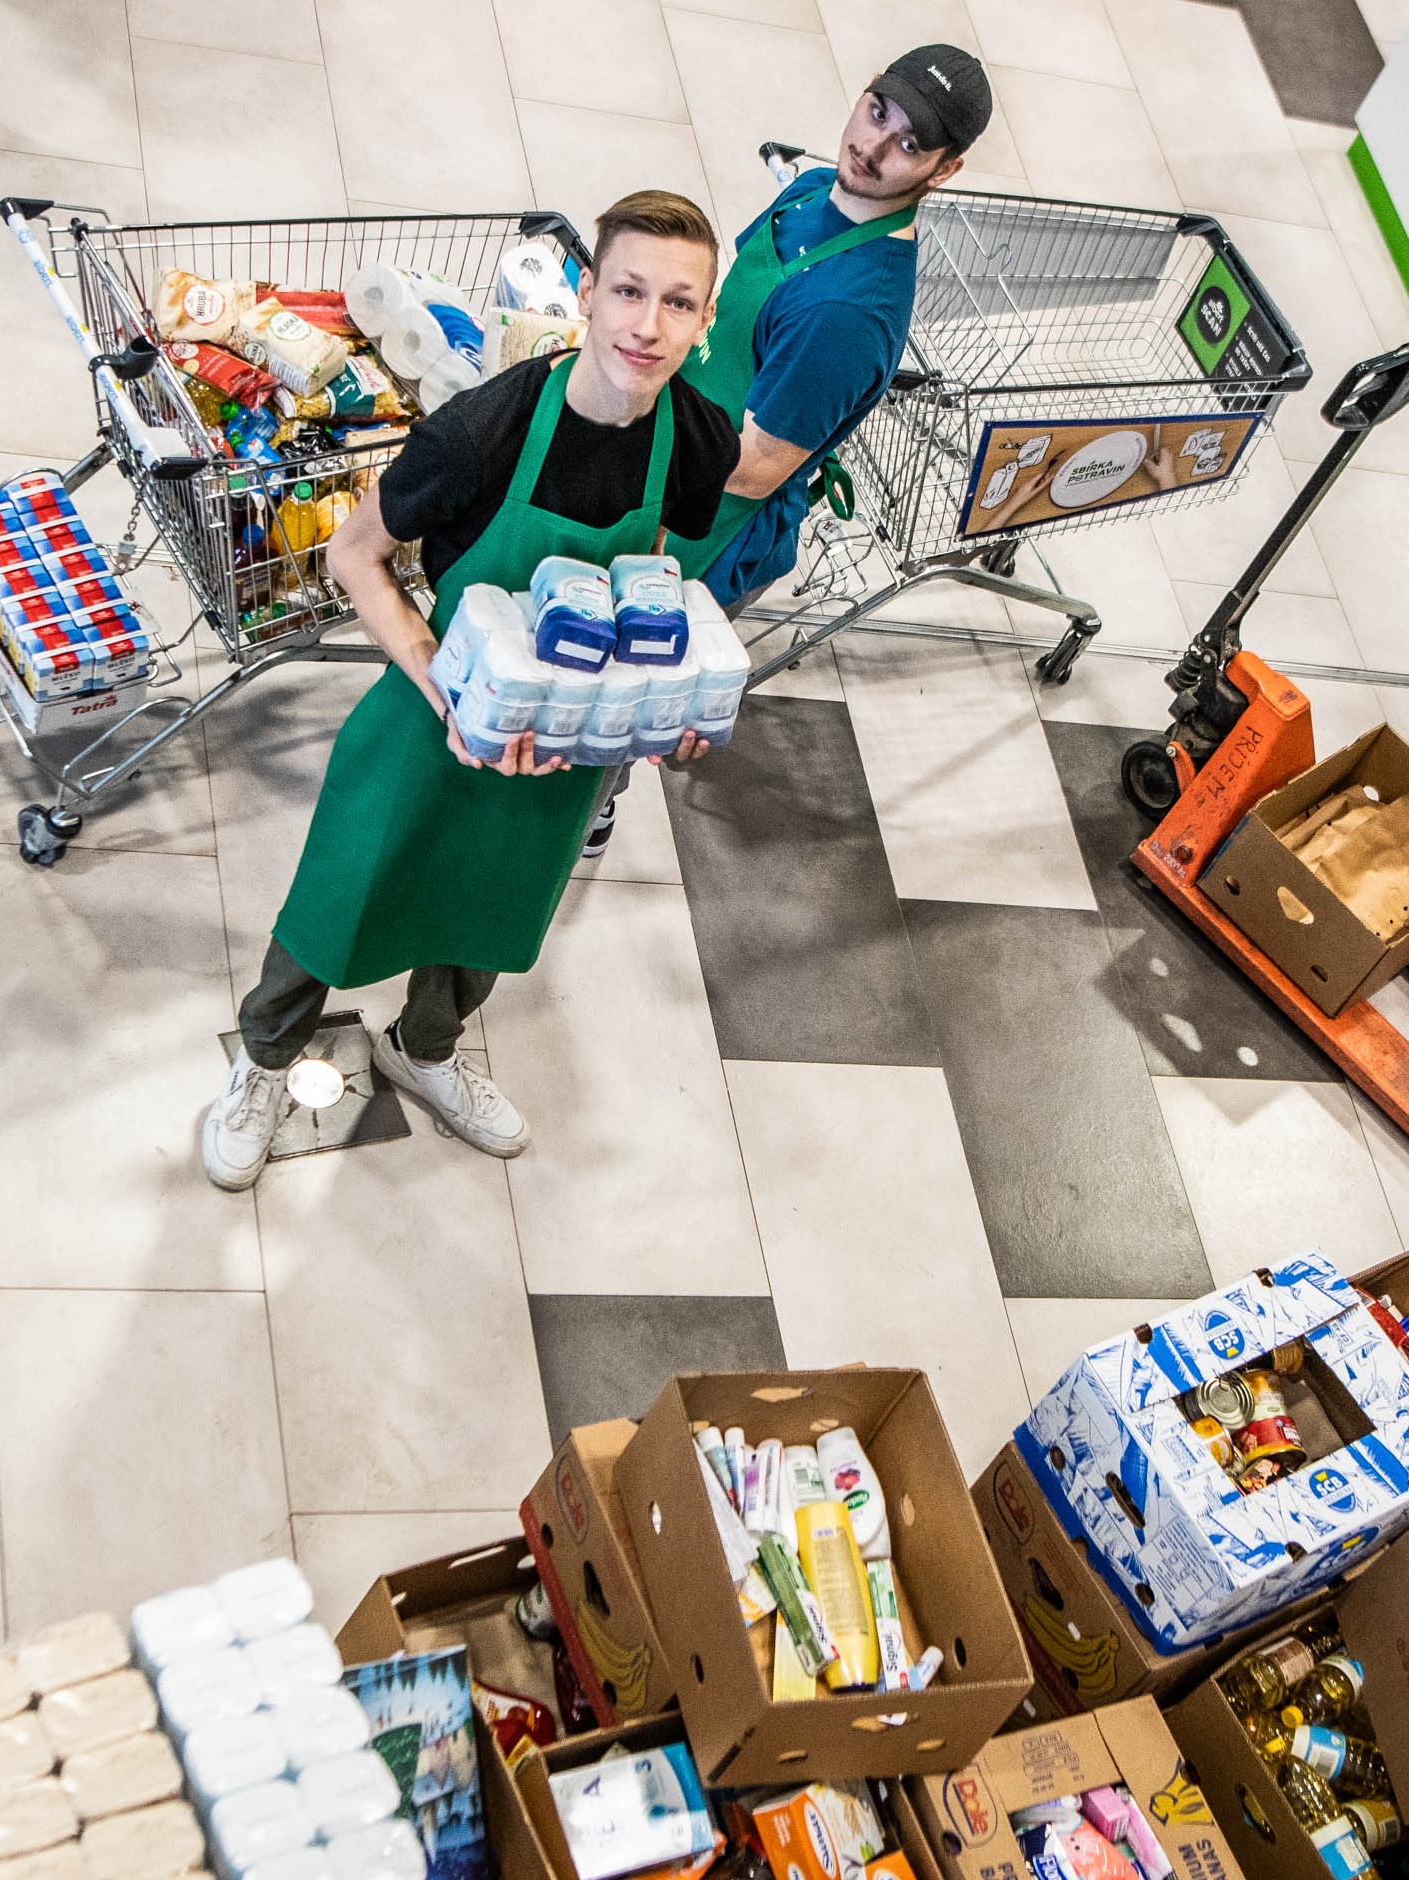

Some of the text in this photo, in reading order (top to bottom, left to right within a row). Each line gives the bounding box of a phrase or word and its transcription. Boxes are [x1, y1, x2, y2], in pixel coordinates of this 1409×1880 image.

[937, 74, 949, 85] do
[1199, 305, 1222, 336] SCAN
[1068, 465, 1124, 483] POTRAVIN
[71, 697, 118, 715] Tatra
[1213, 1327, 1239, 1353] SCB
[1315, 1476, 1342, 1498] SCB
[958, 1778, 990, 1835] Dole
